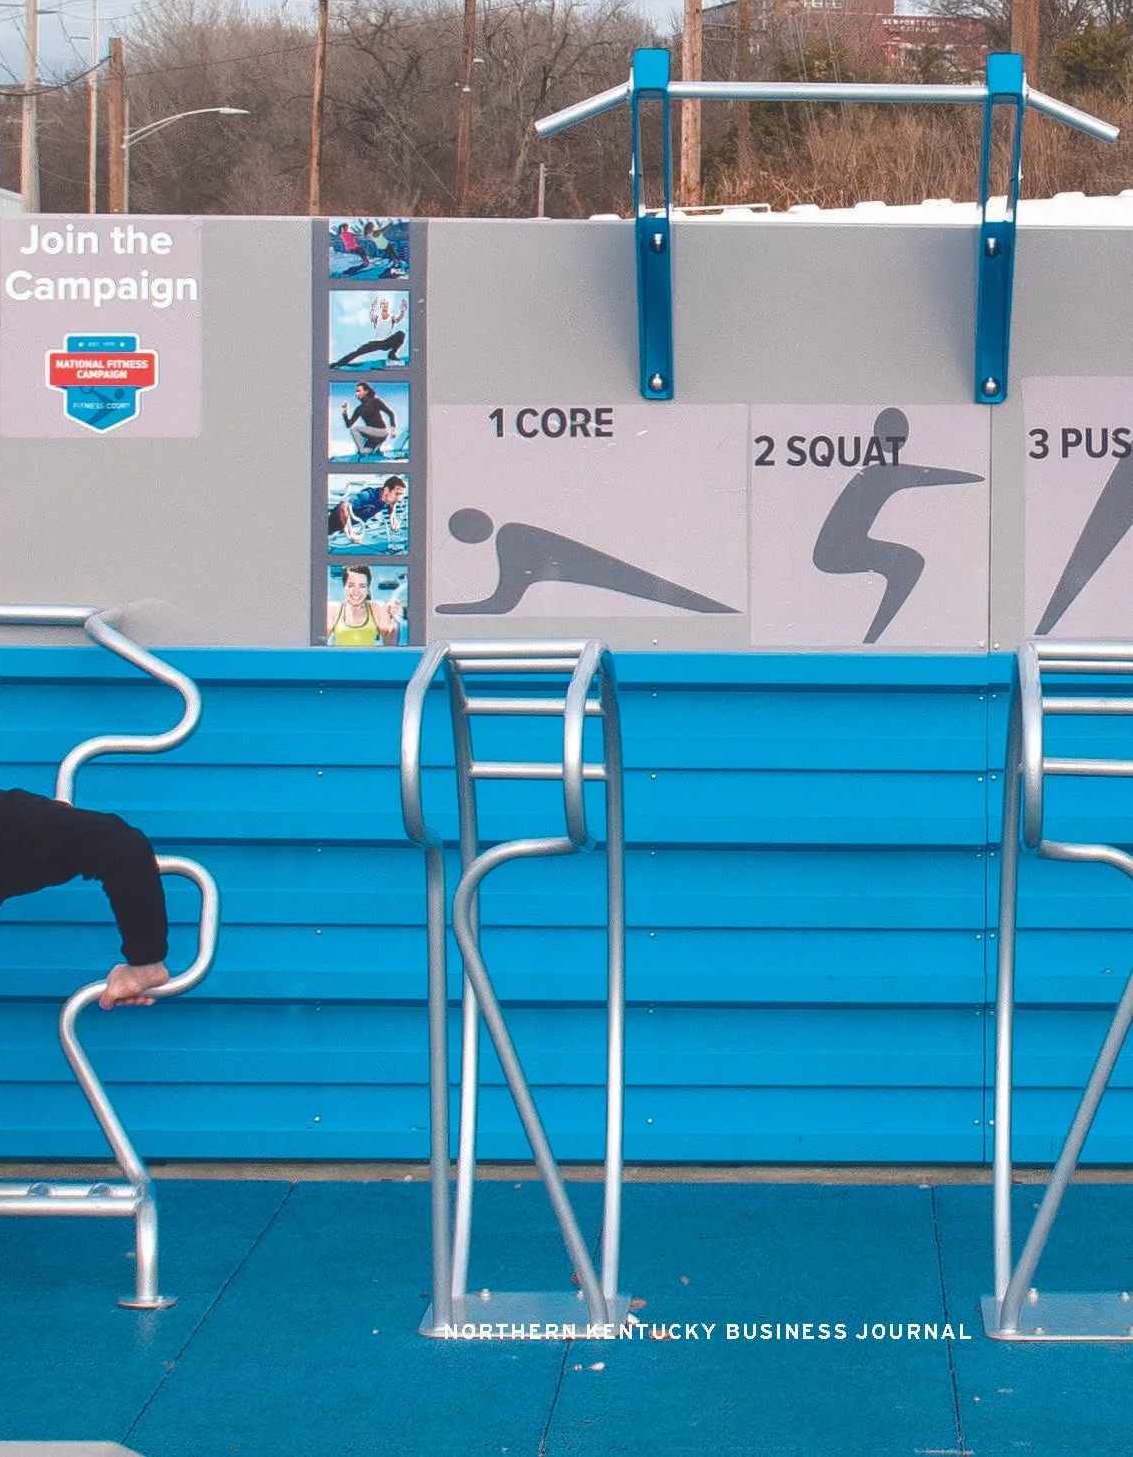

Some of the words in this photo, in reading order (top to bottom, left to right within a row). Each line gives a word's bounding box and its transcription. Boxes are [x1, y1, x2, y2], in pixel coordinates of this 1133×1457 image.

[20, 224, 99, 256] Join
[110, 224, 174, 256] the
[4, 269, 198, 310] Campaign
[55, 359, 105, 370] NATIONAL
[106, 359, 150, 370] FITNESS
[76, 369, 128, 380] CAMPAIGN
[489, 408, 505, 438] 1
[516, 408, 614, 438] CORE
[755, 435, 776, 466] 2
[786, 435, 907, 467] SQUAT
[1028, 428, 1050, 459] 3
[1061, 427, 1132, 459] PUS
